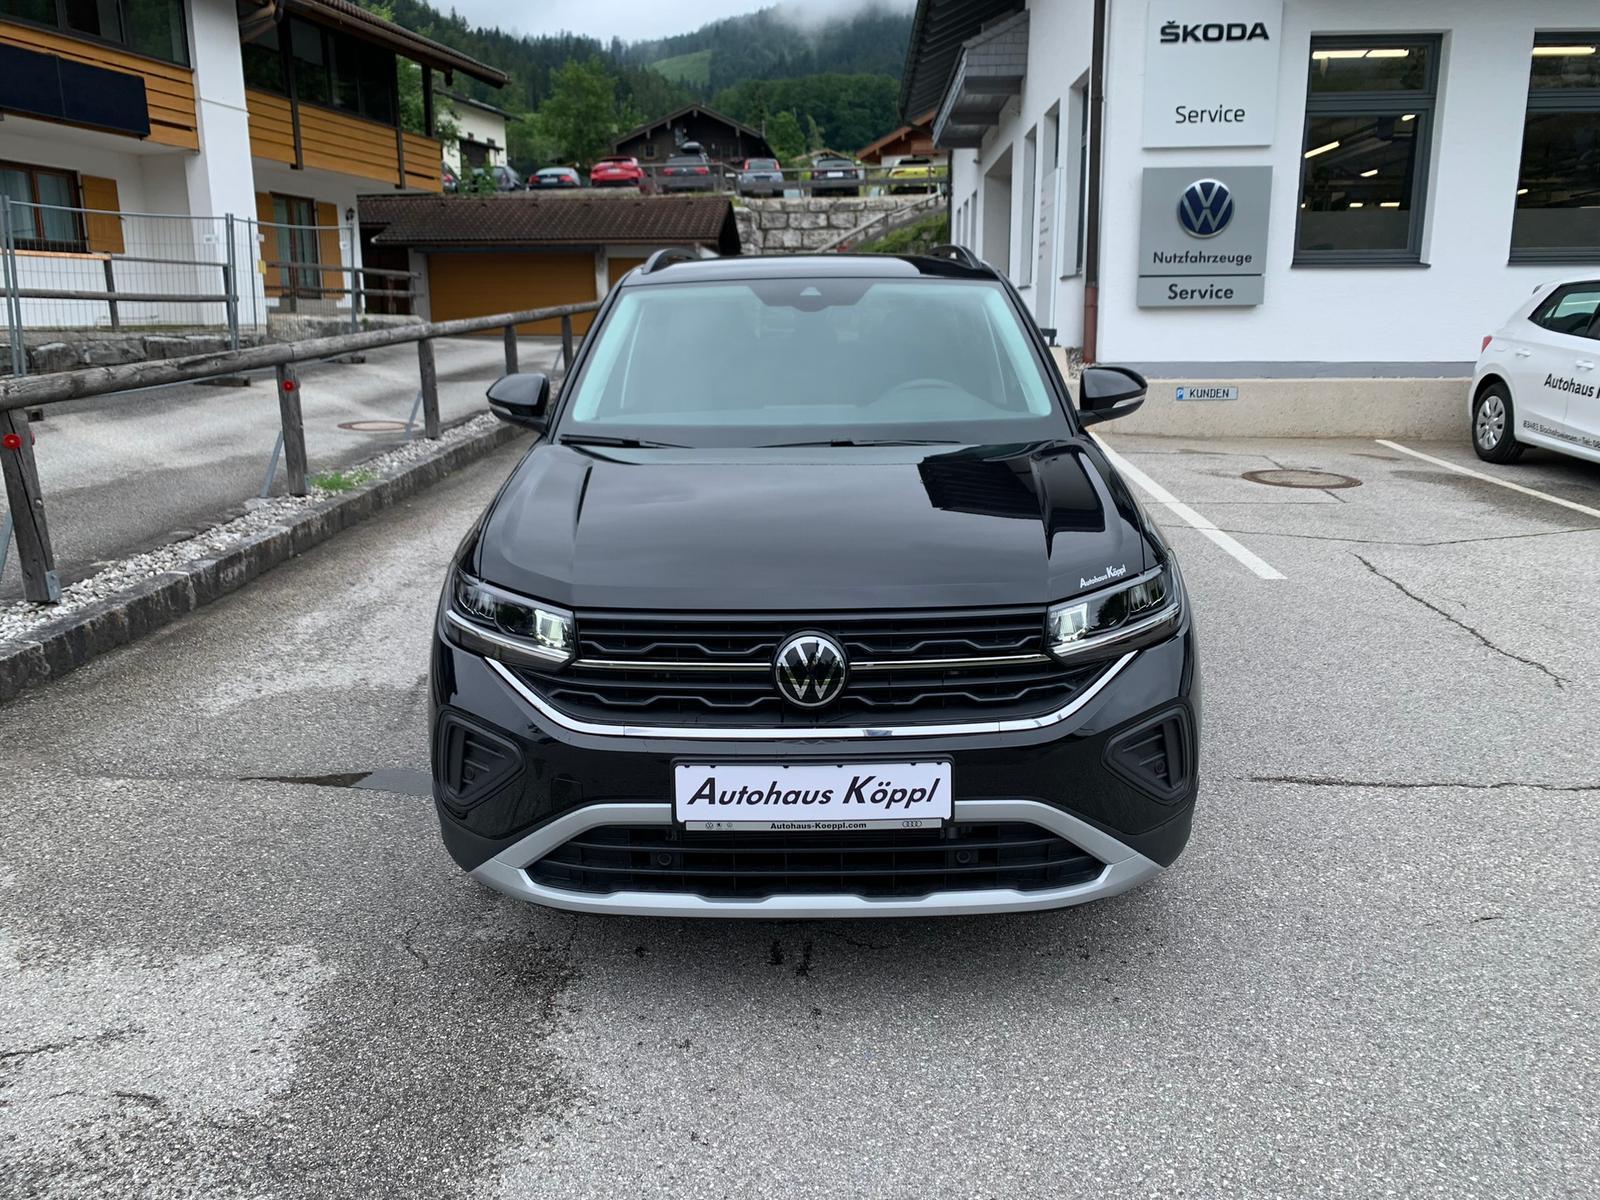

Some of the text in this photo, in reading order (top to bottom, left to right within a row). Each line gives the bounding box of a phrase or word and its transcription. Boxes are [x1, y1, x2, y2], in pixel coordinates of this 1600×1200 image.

[1160, 20, 1269, 43] ŠKODA
[1175, 104, 1245, 124] Service
[1153, 250, 1252, 266] Nutzfahrzeuge
[1168, 283, 1234, 300] Service
[1189, 388, 1230, 399] KUNDEN
[1544, 373, 1595, 398] Autohaus
[1106, 564, 1127, 578] Köppl
[687, 776, 941, 809] Autohaus Köppl
[770, 821, 867, 831] Autohaus-Koeppl.com
